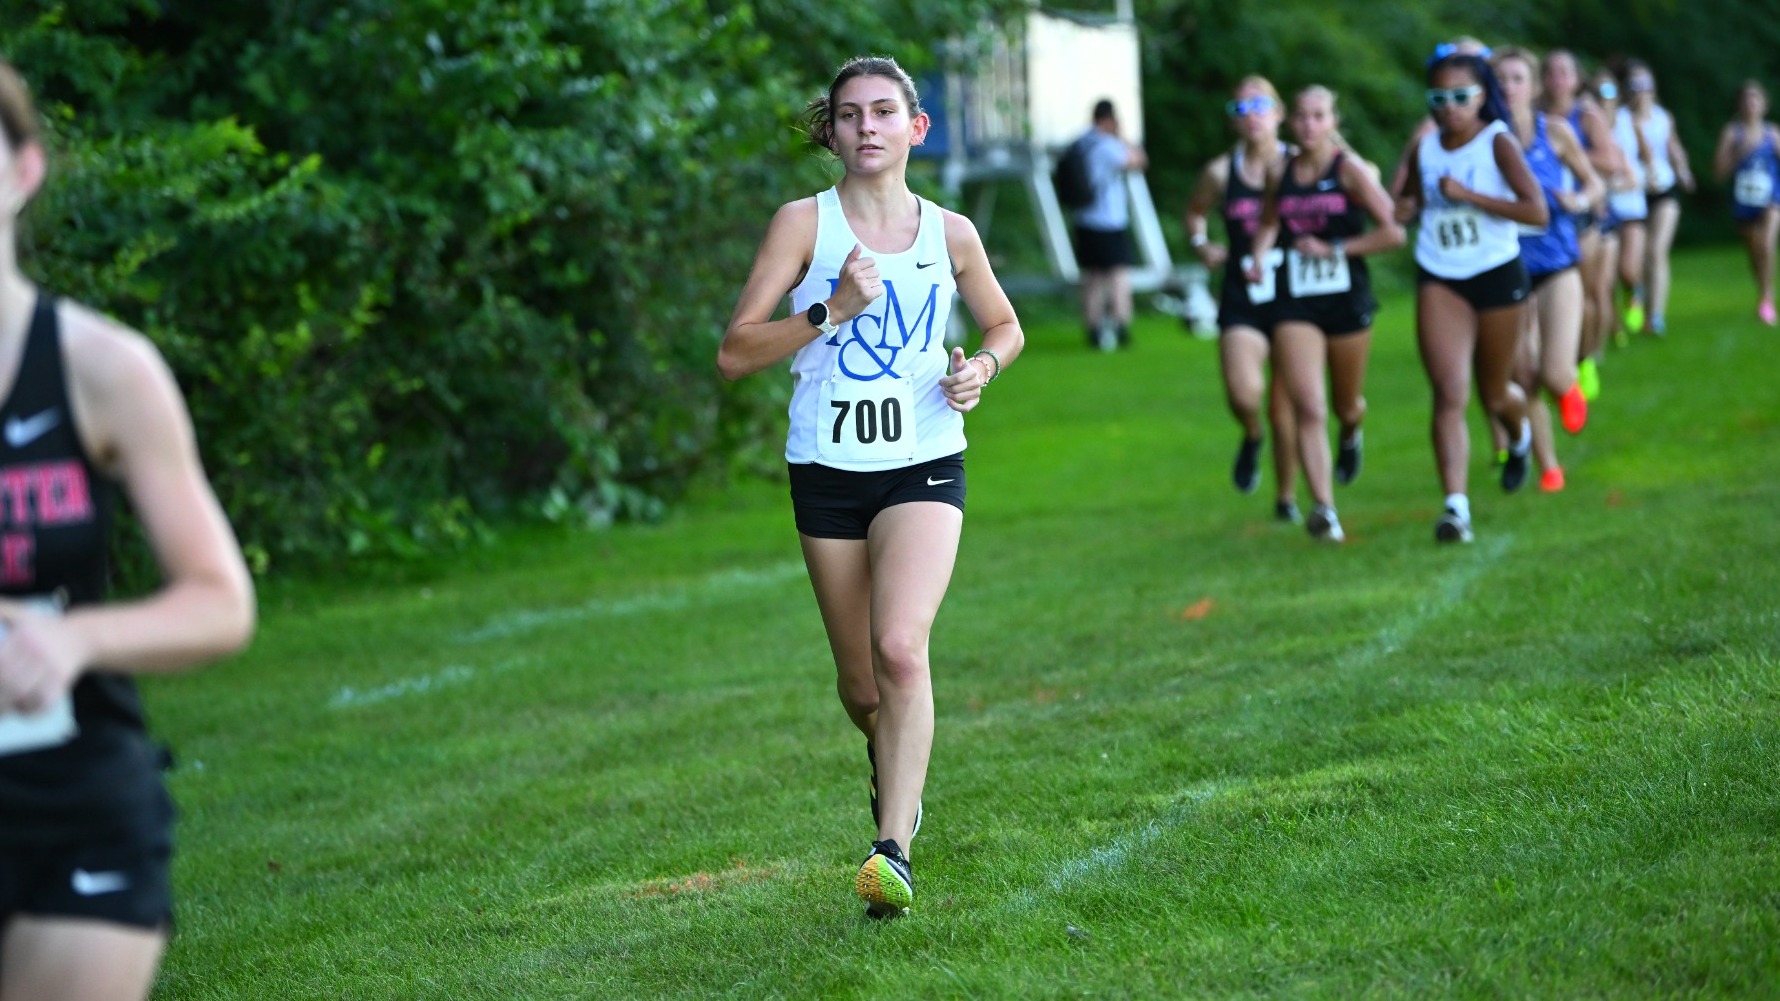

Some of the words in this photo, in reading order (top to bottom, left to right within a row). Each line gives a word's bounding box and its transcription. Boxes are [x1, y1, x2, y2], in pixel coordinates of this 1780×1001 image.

[1438, 216, 1480, 249] 693
[831, 397, 902, 444] 700
[0, 461, 94, 524] TER
